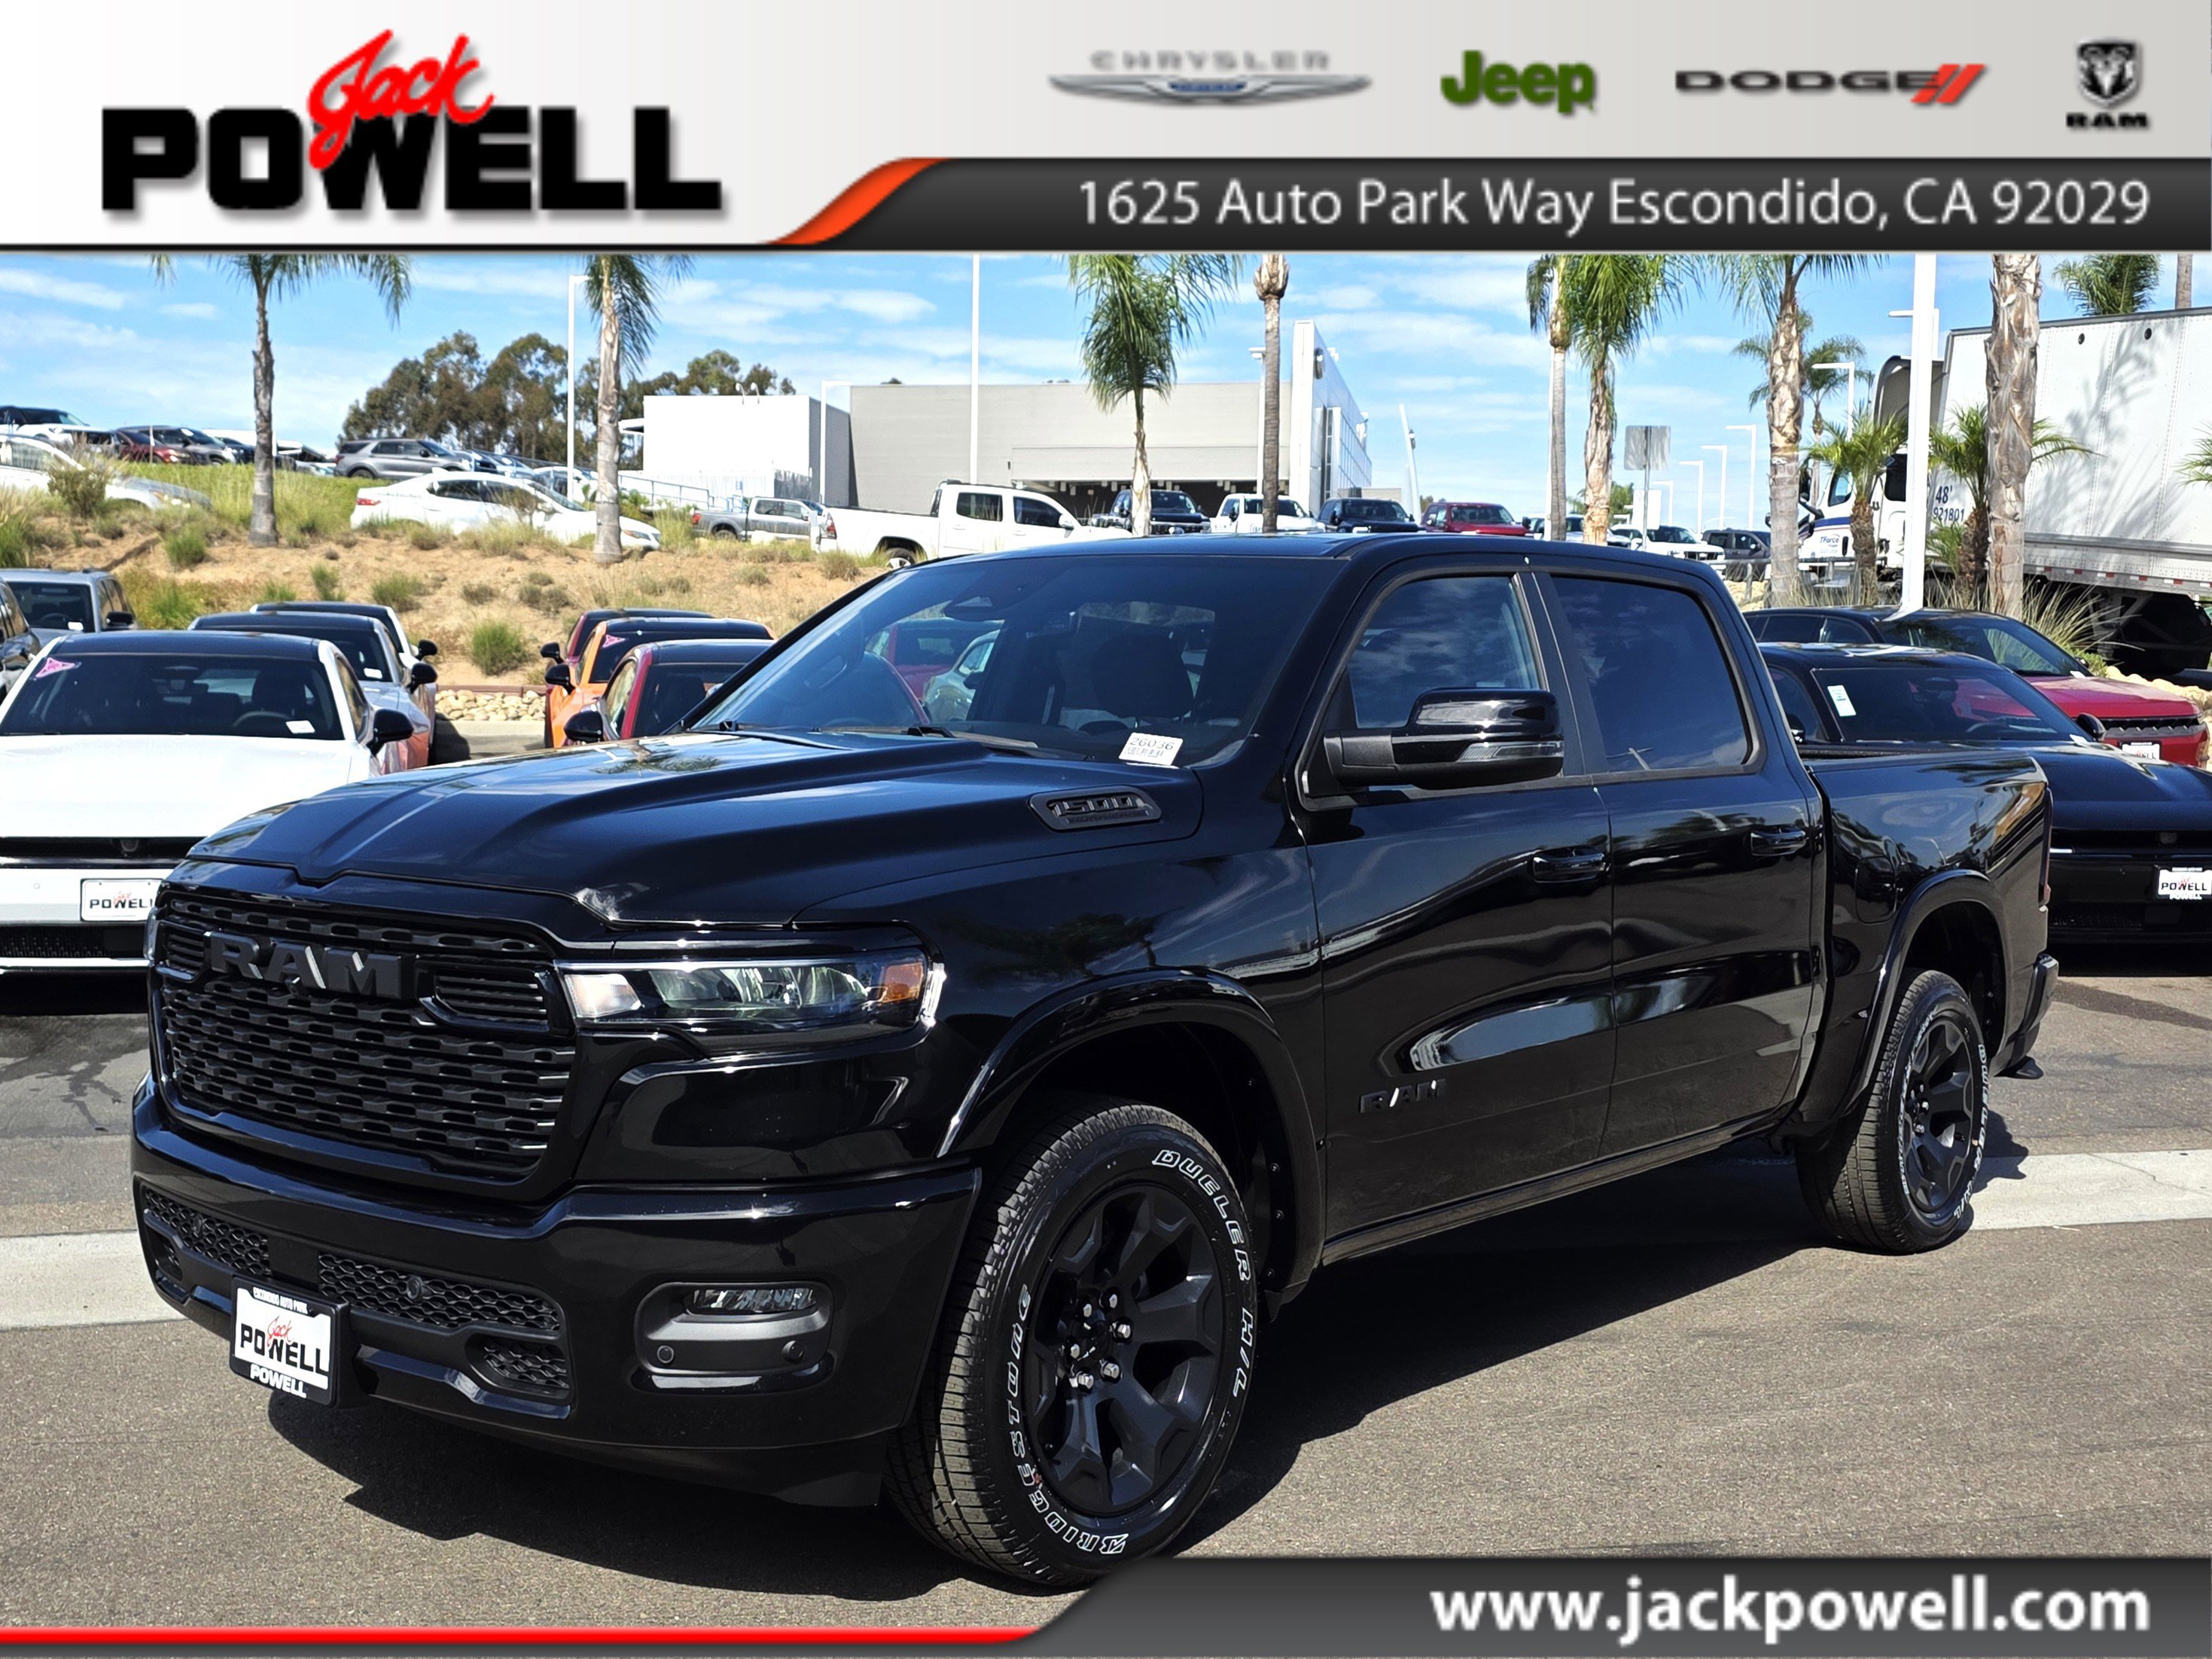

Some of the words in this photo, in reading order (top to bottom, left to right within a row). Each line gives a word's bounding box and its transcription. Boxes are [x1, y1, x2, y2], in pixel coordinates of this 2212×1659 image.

[1129, 736, 1175, 751] 26036
[1047, 796, 1139, 818] 1500
[2161, 882, 2208, 891] POWELL
[203, 931, 404, 1000] RAM
[1359, 1078, 1446, 1114] RAM
[1151, 1149, 1252, 1282] DUELER
[267, 1315, 294, 1347] Jack
[240, 1322, 330, 1377] POWELL
[249, 1363, 307, 1399] POWELL
[1006, 1282, 1130, 1555] BRIDGESTONE
